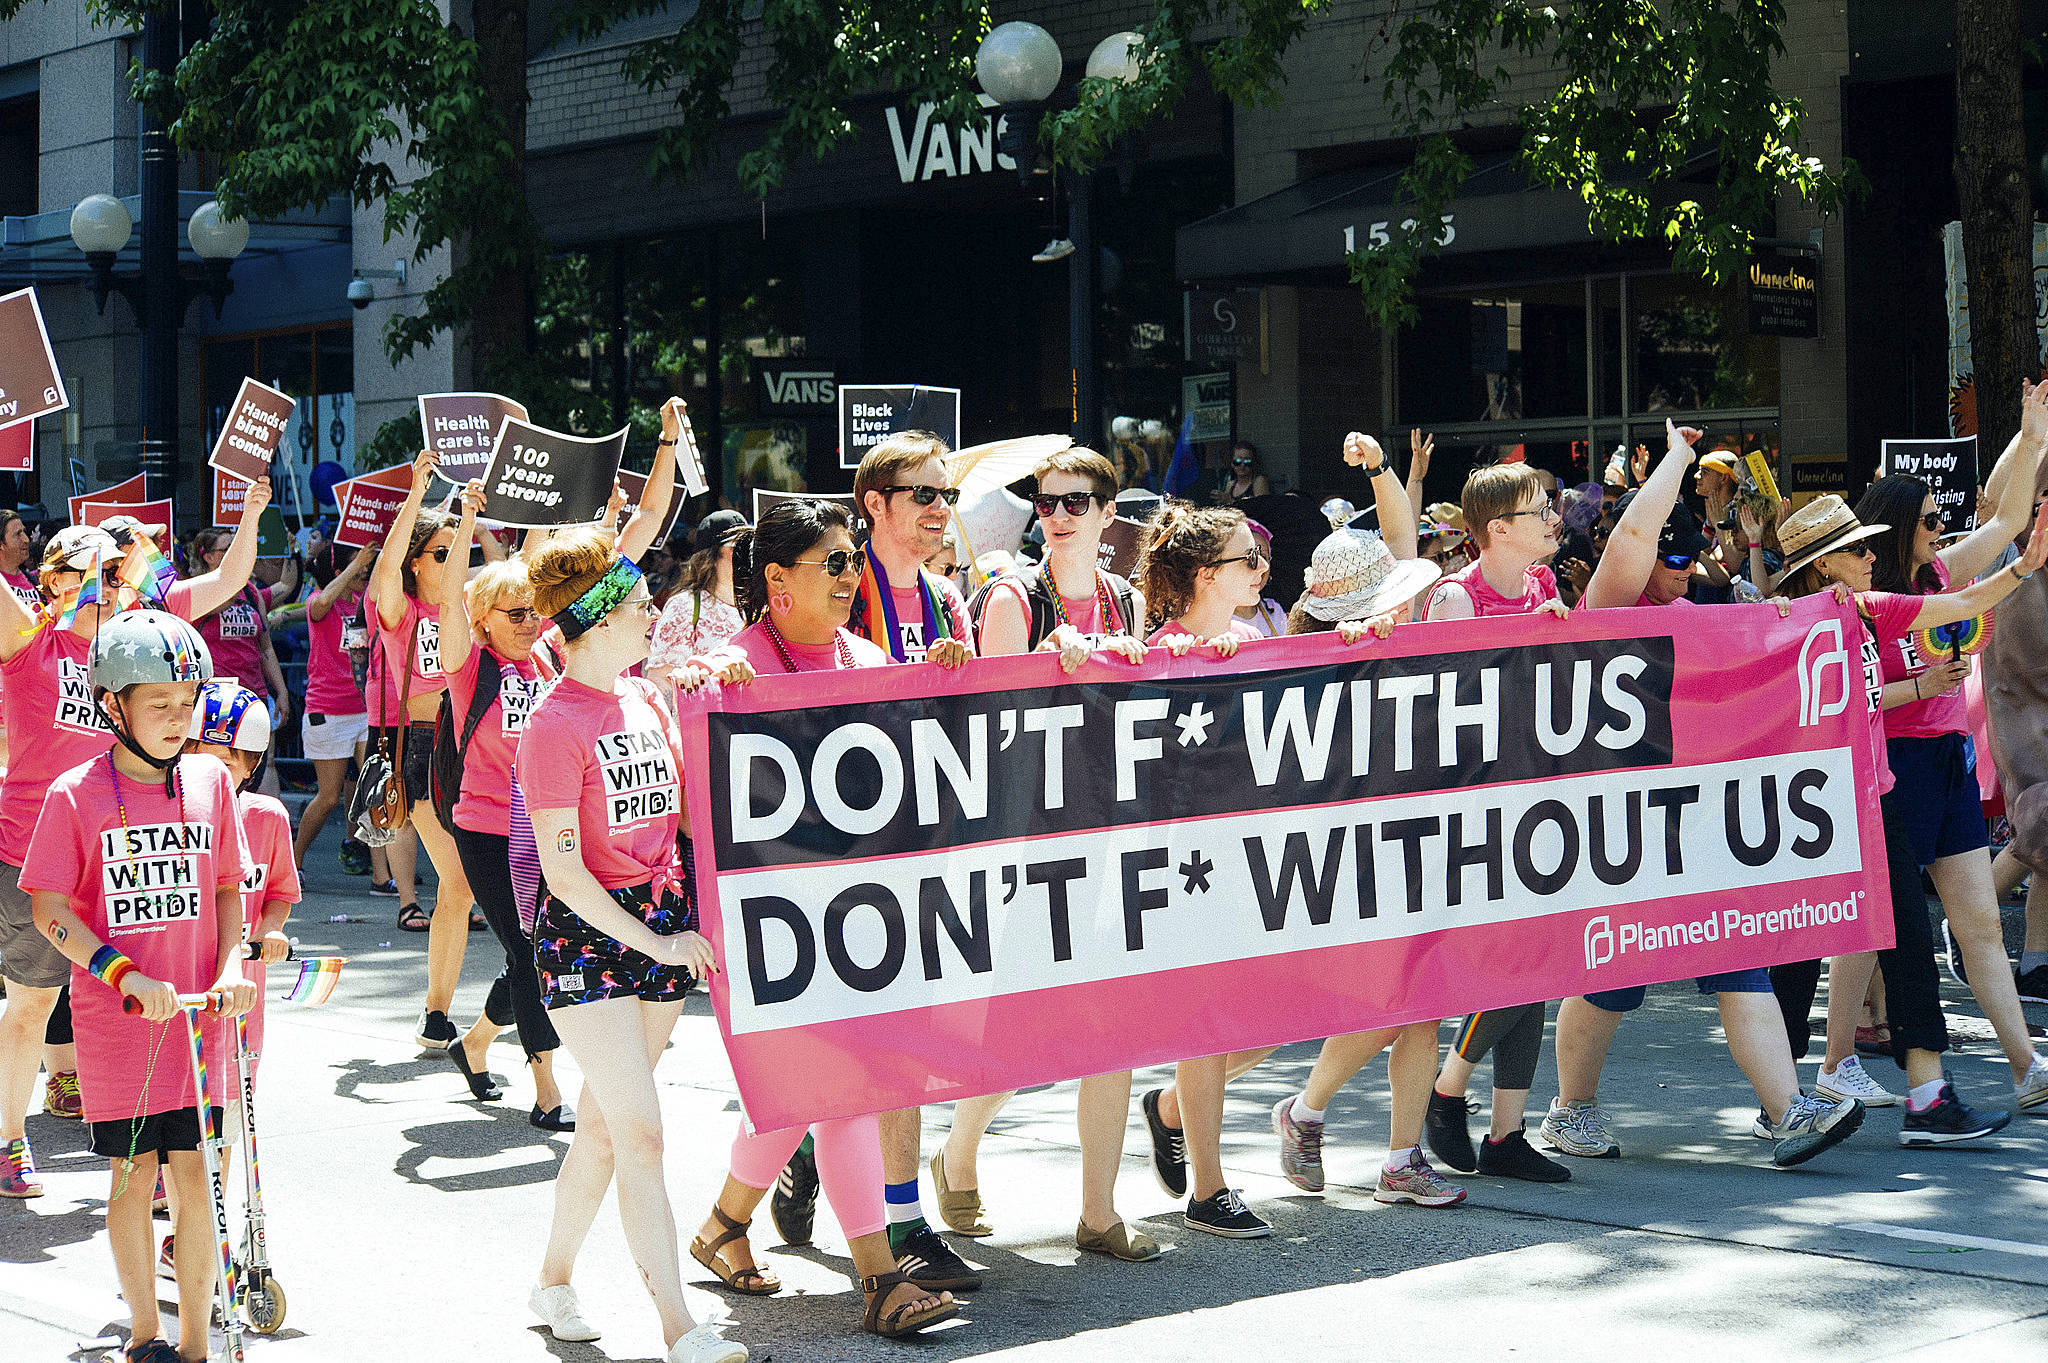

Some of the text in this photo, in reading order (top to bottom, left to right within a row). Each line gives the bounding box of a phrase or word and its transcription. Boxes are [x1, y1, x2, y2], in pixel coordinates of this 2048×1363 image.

[1750, 263, 1815, 293] Ummelina
[764, 372, 835, 403] VANS
[241, 400, 280, 432] Hands
[852, 403, 893, 417] Black
[234, 415, 270, 443] birth
[434, 415, 490, 432] Health
[852, 418, 890, 432] Lives
[437, 431, 491, 449] care is
[852, 433, 890, 447] Matt
[512, 444, 550, 468] 100
[1895, 452, 1958, 474] My body
[501, 464, 555, 487] years
[1934, 474, 1943, 487] a
[351, 494, 382, 510] Hands
[495, 483, 563, 506] strong.
[348, 504, 377, 520] birth
[221, 614, 252, 624] WITH
[222, 626, 256, 636] PRIDE
[63, 681, 91, 702] WI
[597, 729, 668, 760] I STAN
[729, 703, 1086, 845] DON'T
[1242, 668, 1500, 788] WITH
[1534, 654, 1649, 758] US
[606, 758, 669, 791] WITH
[106, 833, 114, 857] I
[108, 859, 192, 890] WITH
[740, 856, 1088, 1007] DON'T
[1242, 783, 1701, 932] WITHOUT
[1725, 767, 1836, 868] US
[1620, 911, 1720, 955] Planned
